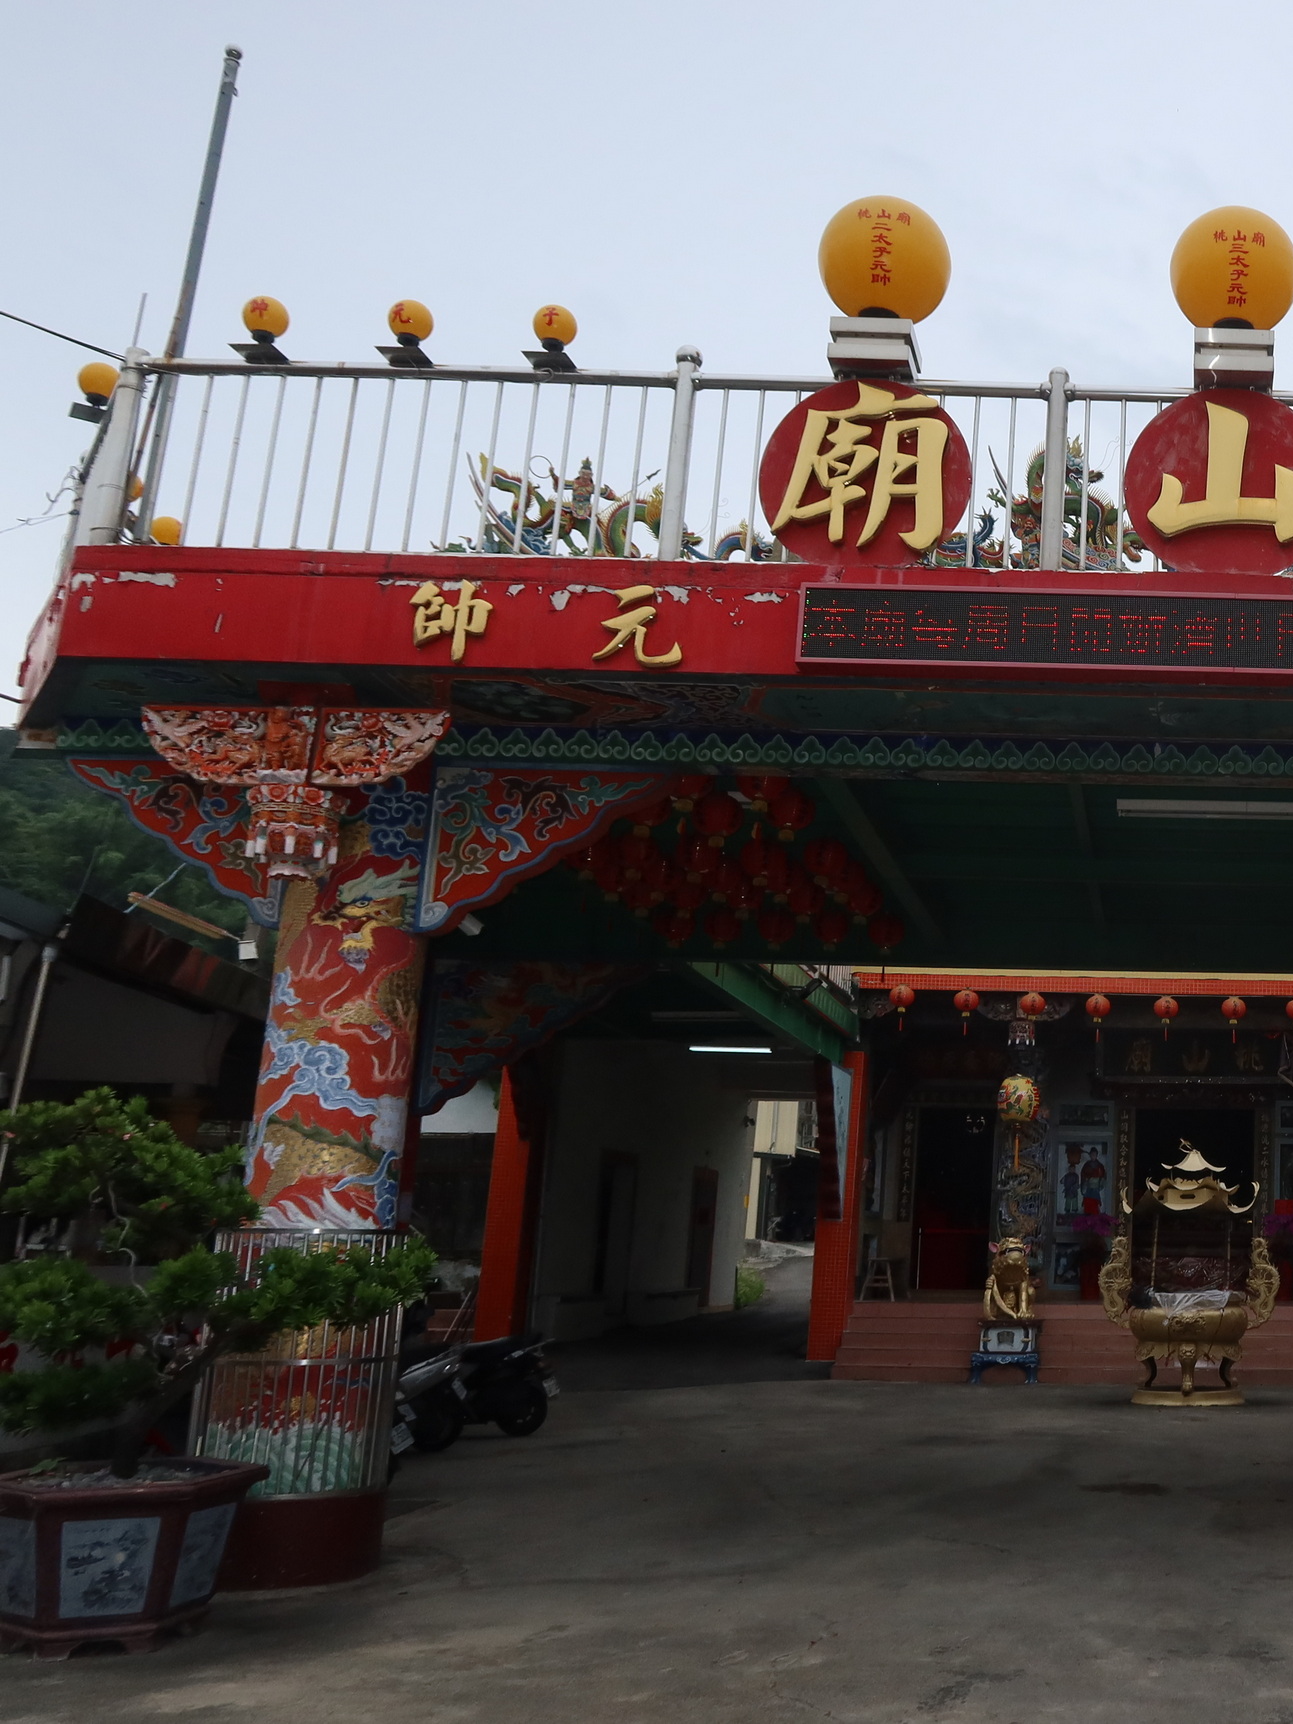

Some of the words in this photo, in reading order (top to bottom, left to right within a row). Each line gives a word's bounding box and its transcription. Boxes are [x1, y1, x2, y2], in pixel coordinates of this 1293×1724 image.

[857, 208, 911, 226] 桃山廟
[1213, 229, 1266, 247] 桃山廟
[870, 222, 893, 287] 二太子元帥
[1227, 243, 1250, 307] 三太子元帥
[392, 303, 412, 324] 元
[543, 308, 559, 326] 子
